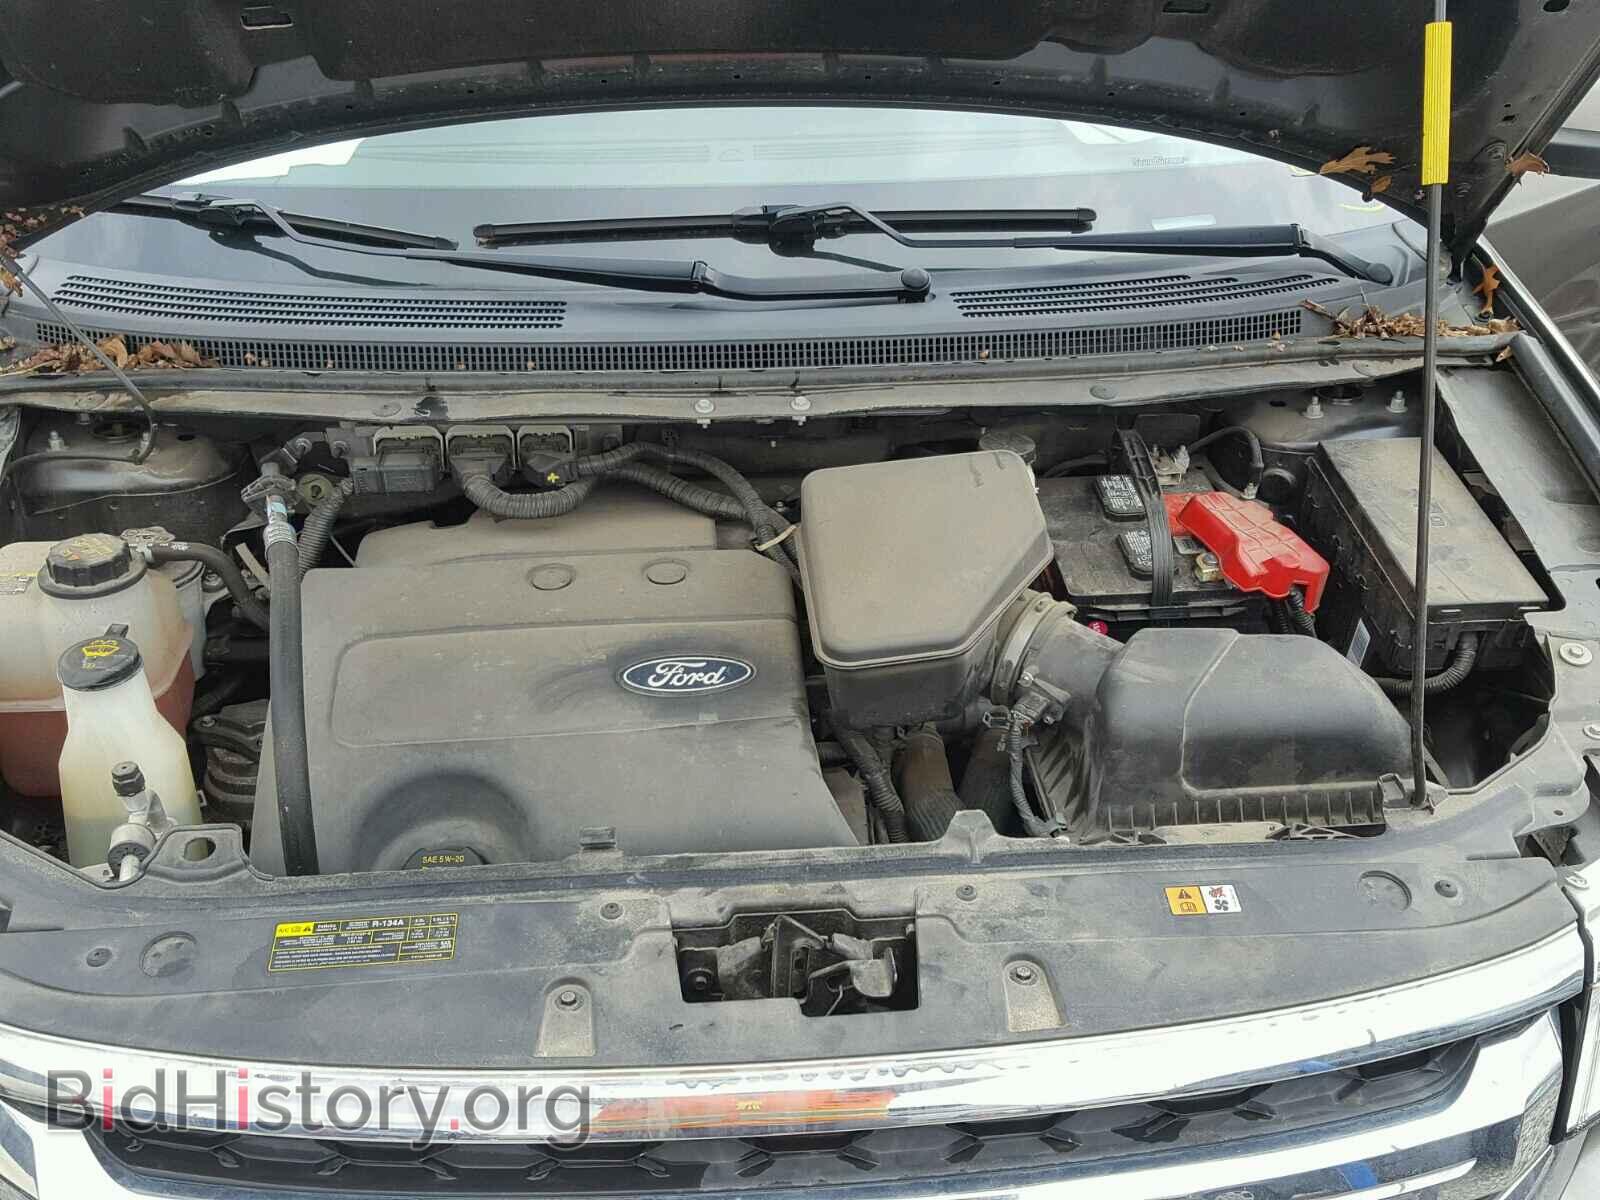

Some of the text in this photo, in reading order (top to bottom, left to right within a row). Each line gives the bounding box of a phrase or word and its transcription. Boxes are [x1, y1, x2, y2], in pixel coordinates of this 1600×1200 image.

[647, 661, 728, 687] Ford
[422, 855, 465, 864] SAE 5W-20
[371, 919, 404, 928] R-134A
